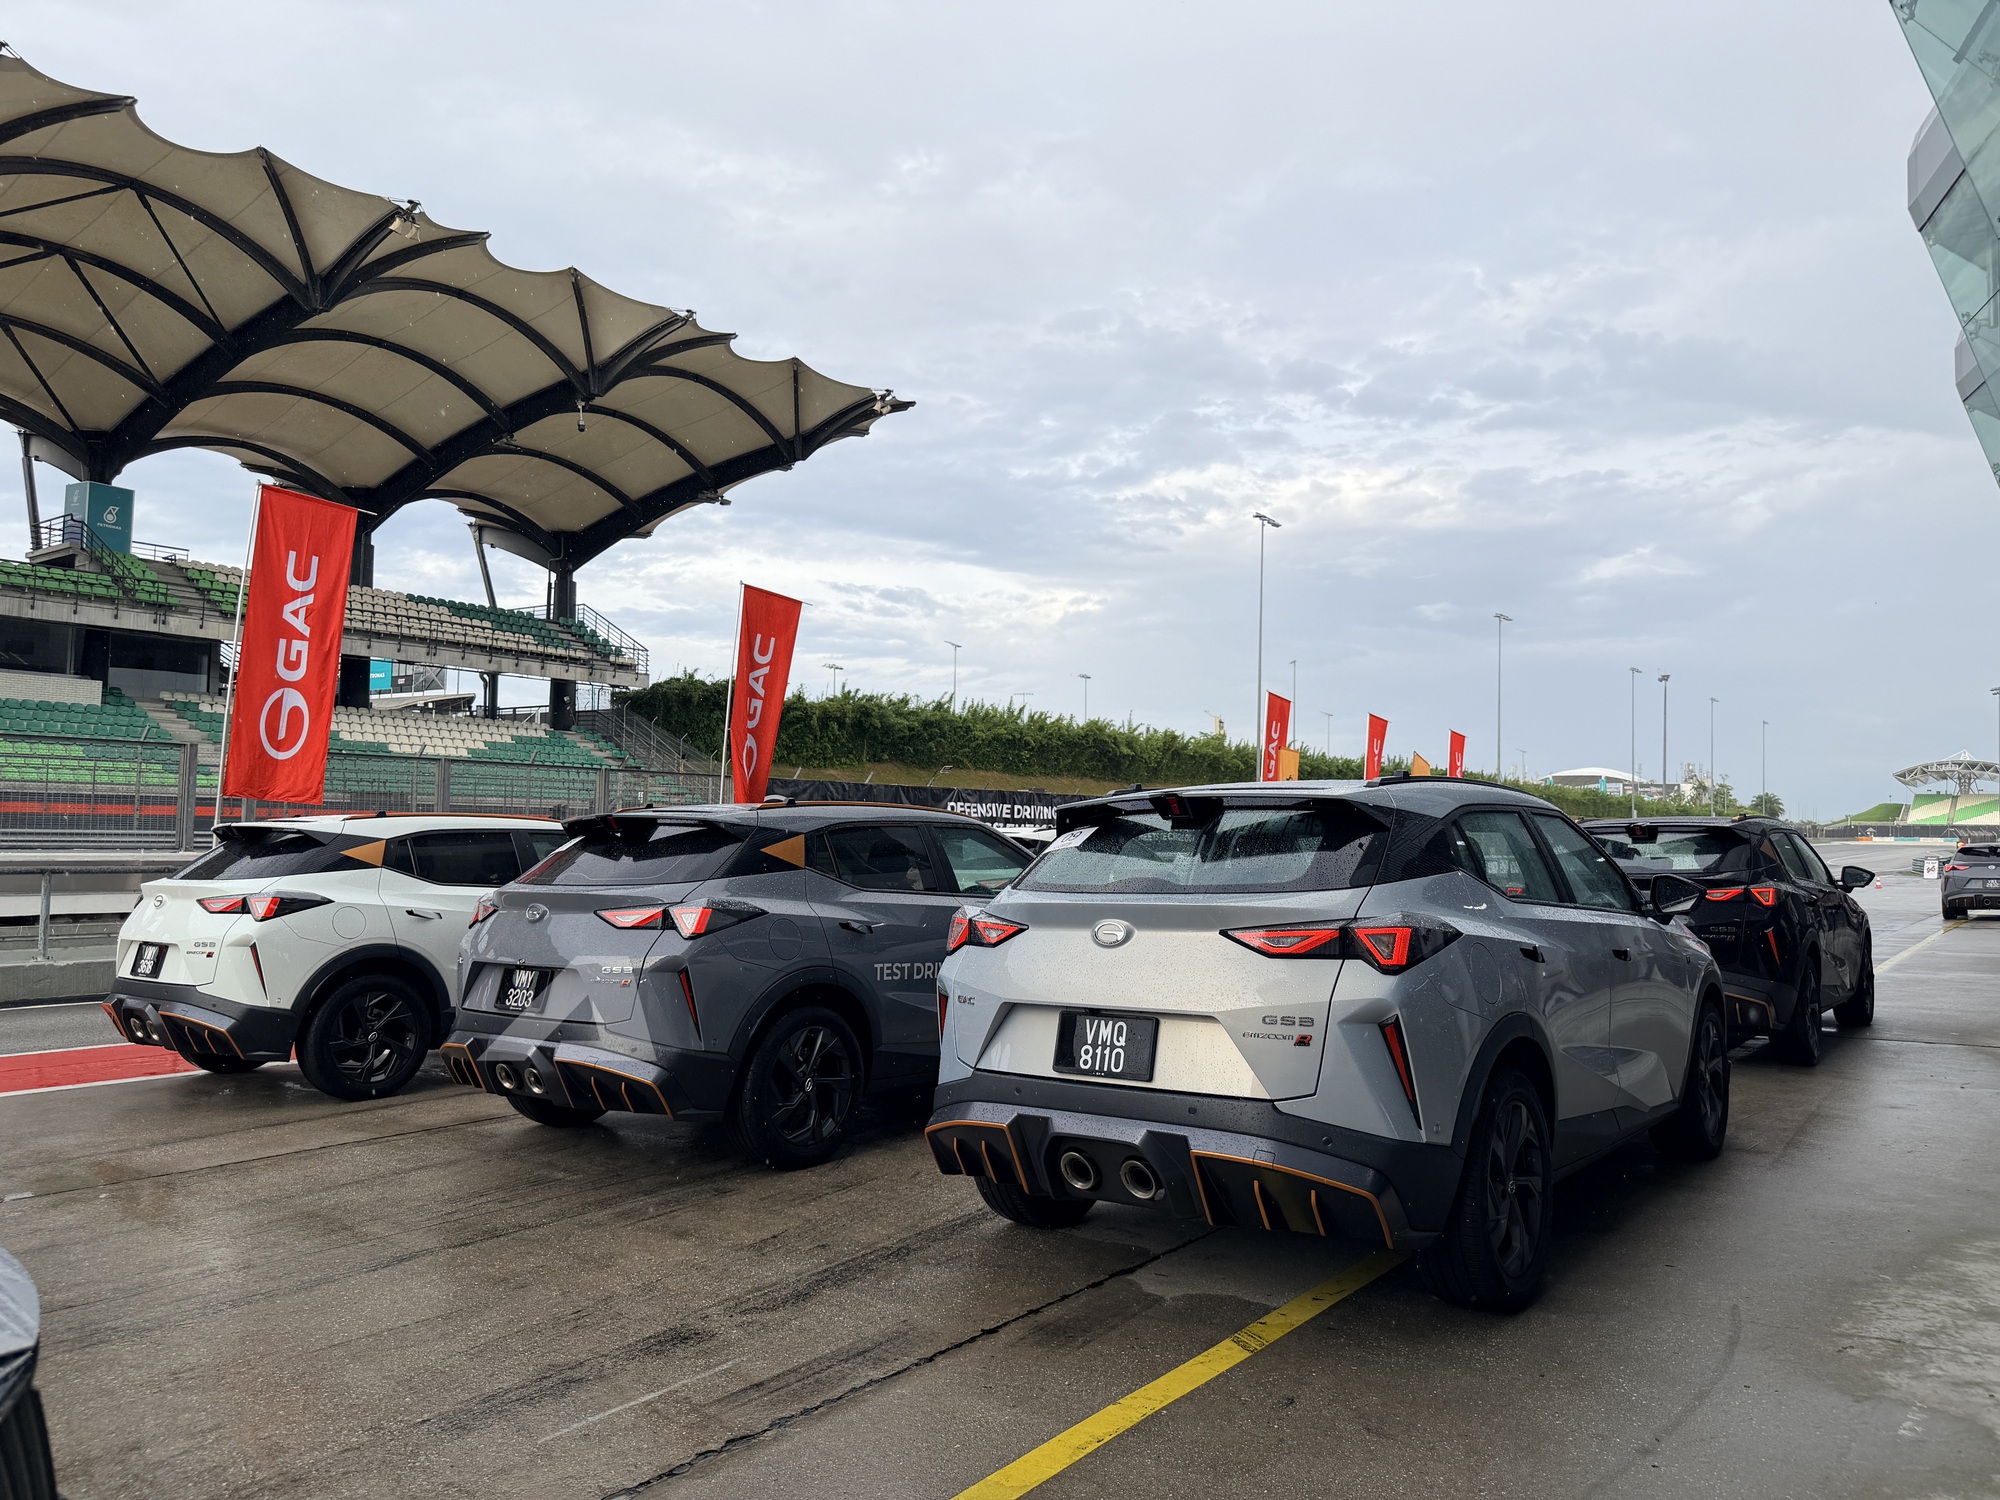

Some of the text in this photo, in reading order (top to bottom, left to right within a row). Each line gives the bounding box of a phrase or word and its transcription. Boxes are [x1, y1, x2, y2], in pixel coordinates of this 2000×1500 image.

[97, 522, 122, 530] PETRONAS
[275, 550, 319, 682] GAC
[746, 633, 776, 729] GAC
[1267, 720, 1281, 779] GAC
[946, 801, 1057, 820] DEFENSIVE DRIVING
[514, 969, 535, 989] VMY
[601, 966, 633, 974] GS3
[874, 962, 944, 980] TEST DRI
[505, 988, 535, 1008] 3203
[1261, 1015, 1315, 1027] GS3
[1085, 1018, 1127, 1047] VMQ
[1079, 1044, 1125, 1073] 8110
